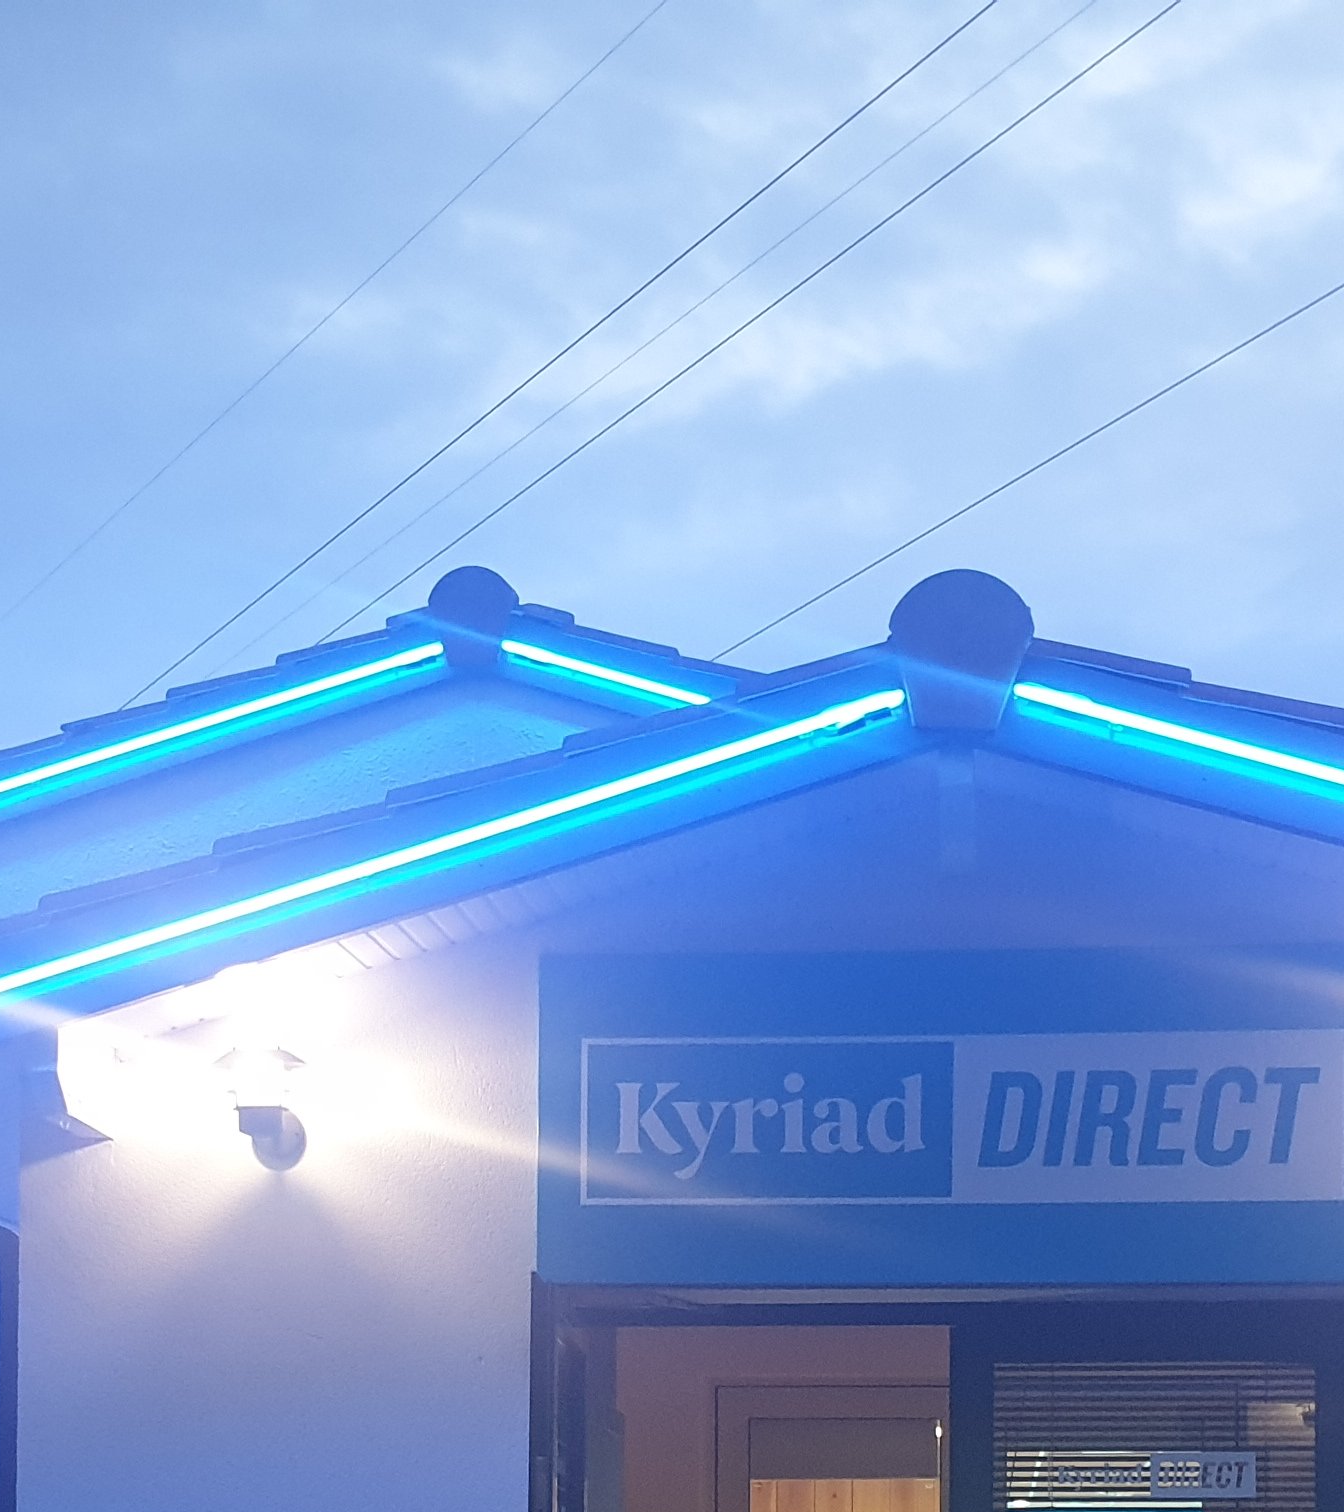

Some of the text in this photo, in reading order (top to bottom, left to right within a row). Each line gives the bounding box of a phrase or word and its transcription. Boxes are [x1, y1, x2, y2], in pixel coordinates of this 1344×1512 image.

[615, 1065, 1321, 1179] Kyriad DIRECT
[1158, 1461, 1249, 1489] DIRECT
